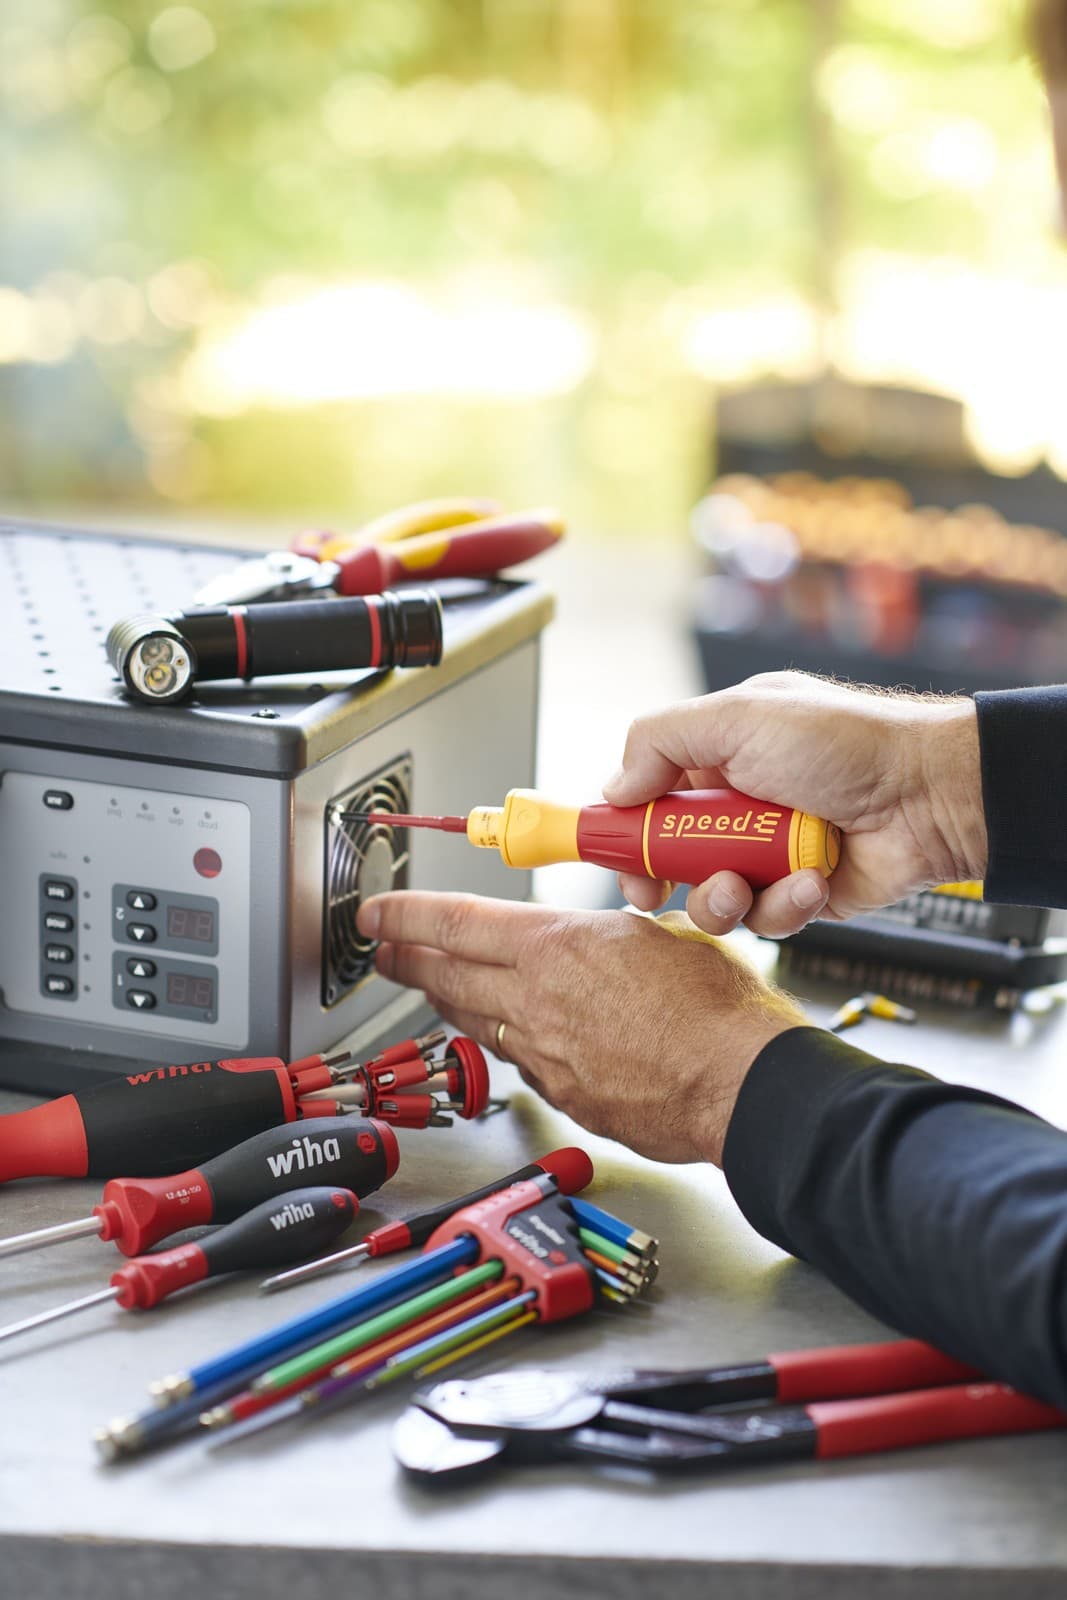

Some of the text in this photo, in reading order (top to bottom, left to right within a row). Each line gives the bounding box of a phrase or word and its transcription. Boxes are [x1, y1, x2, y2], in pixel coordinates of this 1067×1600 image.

[116, 907, 125, 920] 2
[117, 974, 123, 986] 1
[127, 1062, 211, 1087] wiha
[267, 1137, 341, 1177] wiha
[270, 1202, 315, 1231] wiha
